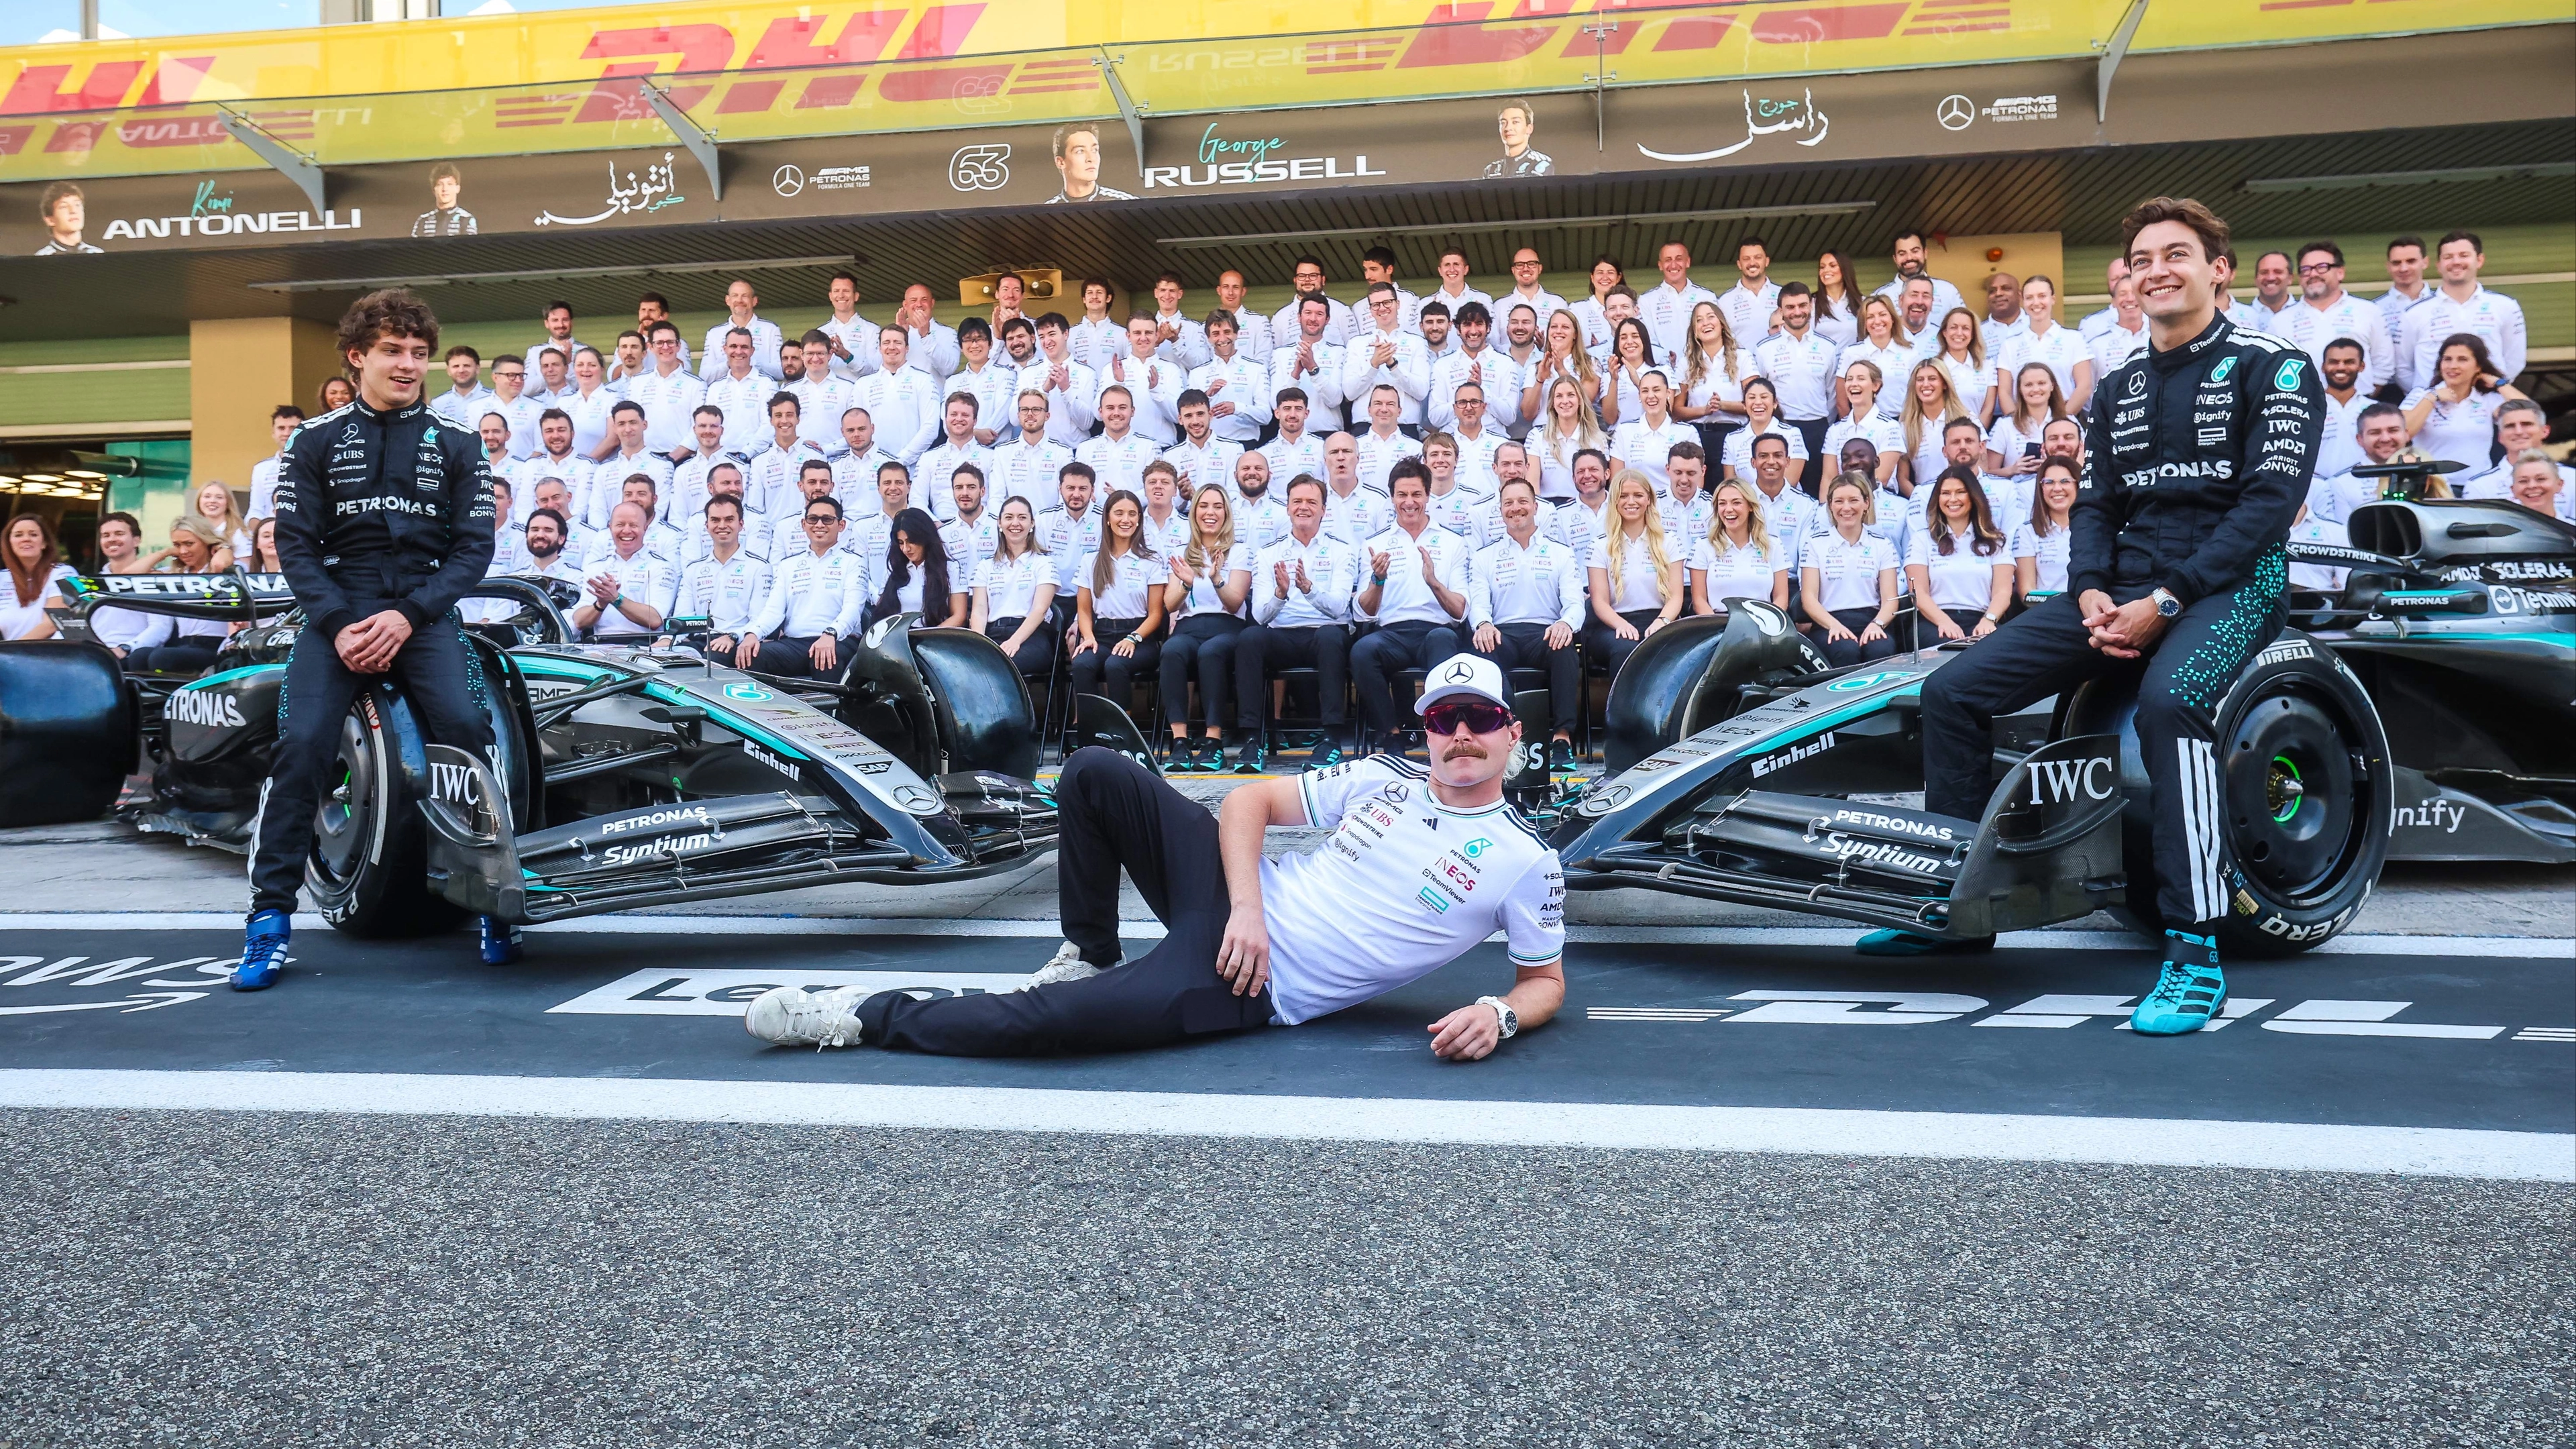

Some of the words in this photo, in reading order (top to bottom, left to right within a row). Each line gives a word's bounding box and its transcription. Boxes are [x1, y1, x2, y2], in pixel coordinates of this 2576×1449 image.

[572, 3, 1014, 123] DHL
[1982, 102, 2057, 116] PETRONAS
[1992, 114, 2024, 123] FORMULA
[2025, 113, 2039, 121] ONE
[2040, 112, 2057, 120] TEAM
[1198, 123, 1288, 183] George
[826, 166, 869, 175] AMG
[948, 143, 1012, 192] 63
[1145, 155, 1386, 188] RUSSELL
[810, 174, 870, 184] PETRONAS
[191, 179, 234, 221] Kimi
[103, 208, 362, 240] ANTONELLI
[2200, 380, 2231, 388] PETRONAS
[2195, 392, 2234, 406] INEOS
[2265, 392, 2308, 405] PETRONAS
[2128, 407, 2145, 421] UBS
[2269, 405, 2310, 421] SOLERA
[2112, 425, 2149, 437] CROWDSTRIKE
[2268, 419, 2302, 435] IWC
[343, 450, 364, 459] UBS
[2118, 441, 2149, 453] Snapdragon
[2262, 438, 2300, 454] AMD
[329, 464, 367, 474] CROWDSTRIKE
[2121, 460, 2233, 488] PETONAS
[337, 476, 366, 484] Snapdragon
[336, 496, 437, 517] PETRONAS
[2291, 543, 2377, 563] CROWDSTRIKE
[2491, 562, 2565, 580] SOLERA
[106, 576, 289, 594] PETRONA
[2391, 596, 2449, 606] PETRONAS
[2510, 587, 2576, 609] TeamV
[2256, 639, 2314, 667] PIRELLI
[164, 688, 247, 727] ETRONAS
[798, 731, 857, 741] INEOS
[1708, 725, 1762, 737] INEOS
[743, 739, 800, 782] Einhell
[1751, 731, 1837, 778] Einhell
[857, 763, 890, 773] SAP
[1640, 760, 1671, 770] SAP
[429, 763, 481, 805] IWC
[2027, 757, 2114, 805] IWC
[602, 806, 707, 835] PETRONAS
[1352, 814, 1384, 839] CROWDSTRIKE
[1371, 808, 1394, 826] UBS
[1835, 809, 1953, 841] PETRONAS
[2390, 800, 2465, 836] nify
[1346, 828, 1372, 850] Snapdragon
[602, 833, 710, 866] Syntium
[1819, 832, 1941, 873] Syntium
[1450, 849, 1481, 874] PETRONAS
[1434, 856, 1477, 892] INEOS
[1430, 873, 1466, 904] TeamViewer
[1415, 897, 1432, 911] Enterprise
[2208, 951, 2219, 963] 63
[1720, 990, 2507, 1039] DHL
